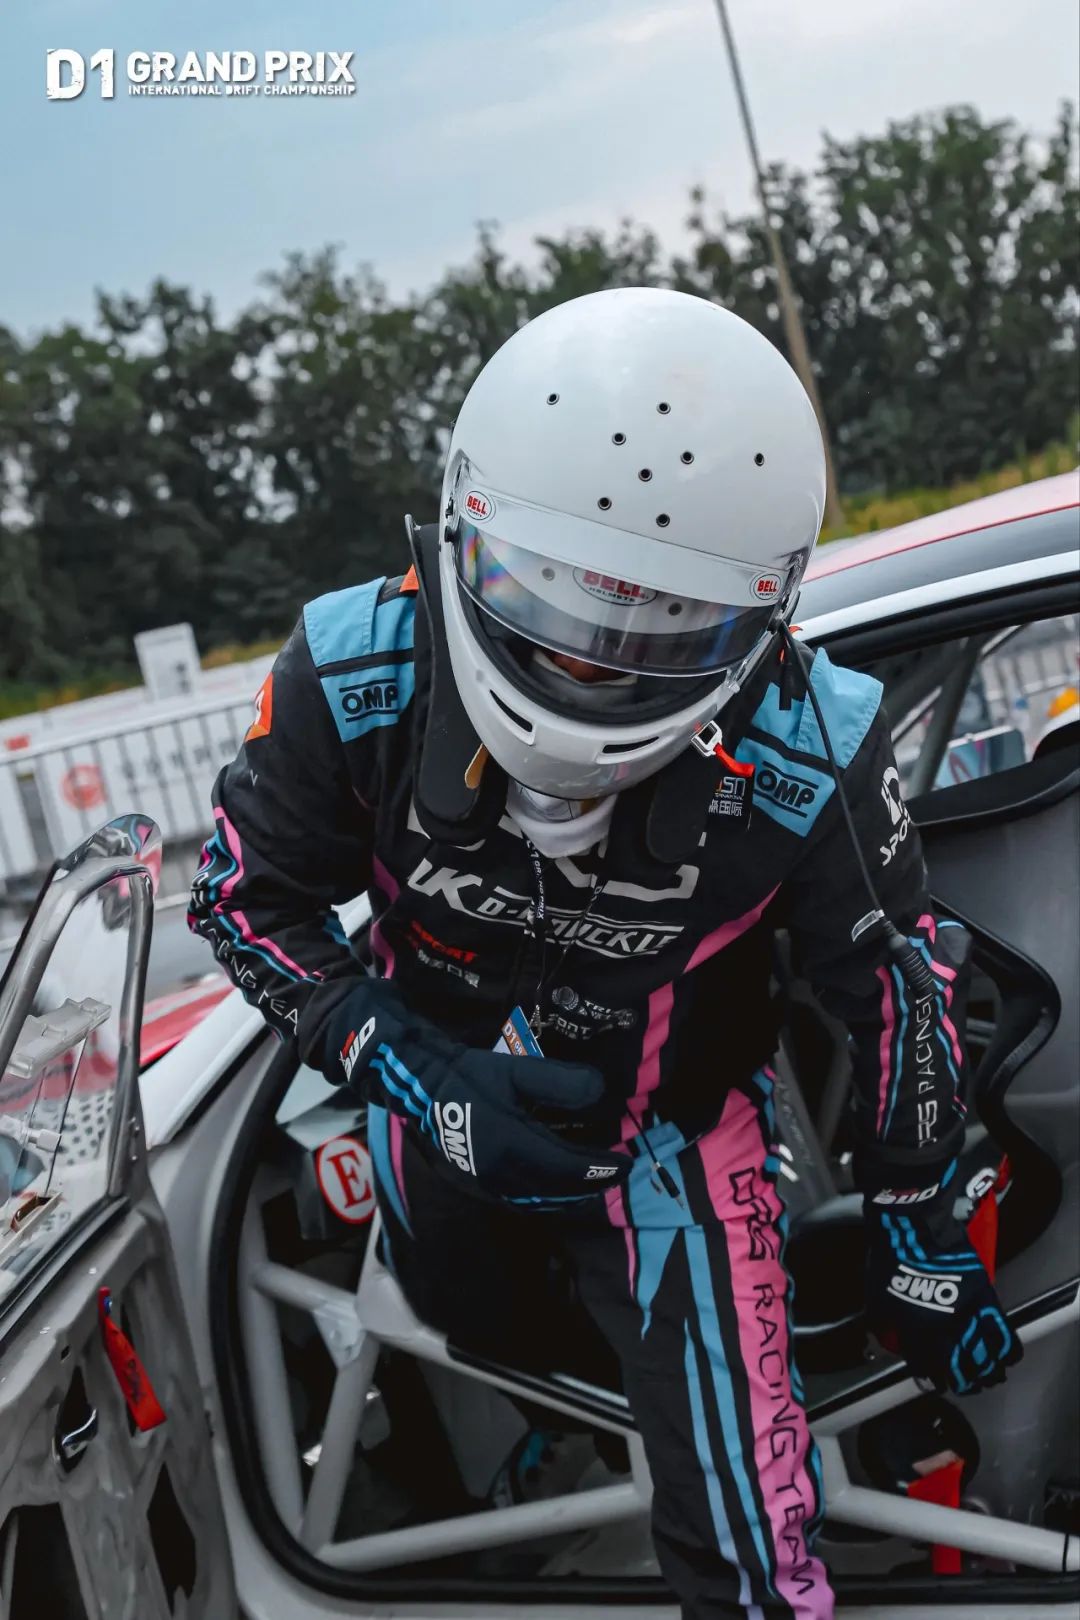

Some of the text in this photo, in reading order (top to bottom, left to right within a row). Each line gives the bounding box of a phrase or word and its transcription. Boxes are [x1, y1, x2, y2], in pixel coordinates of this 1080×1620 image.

[467, 495, 487, 515] BELL
[583, 570, 648, 599] BELL
[757, 580, 777, 592] BELL
[341, 684, 399, 715] OMP
[757, 769, 816, 809] OMP
[258, 990, 300, 1036] TEA
[442, 1101, 472, 1173] OMP
[326, 1149, 373, 1209] E
[586, 1169, 617, 1179] OMP
[891, 1274, 960, 1306] OMP
[753, 1283, 798, 1459] RACING
[775, 1471, 815, 1595] TEAM
